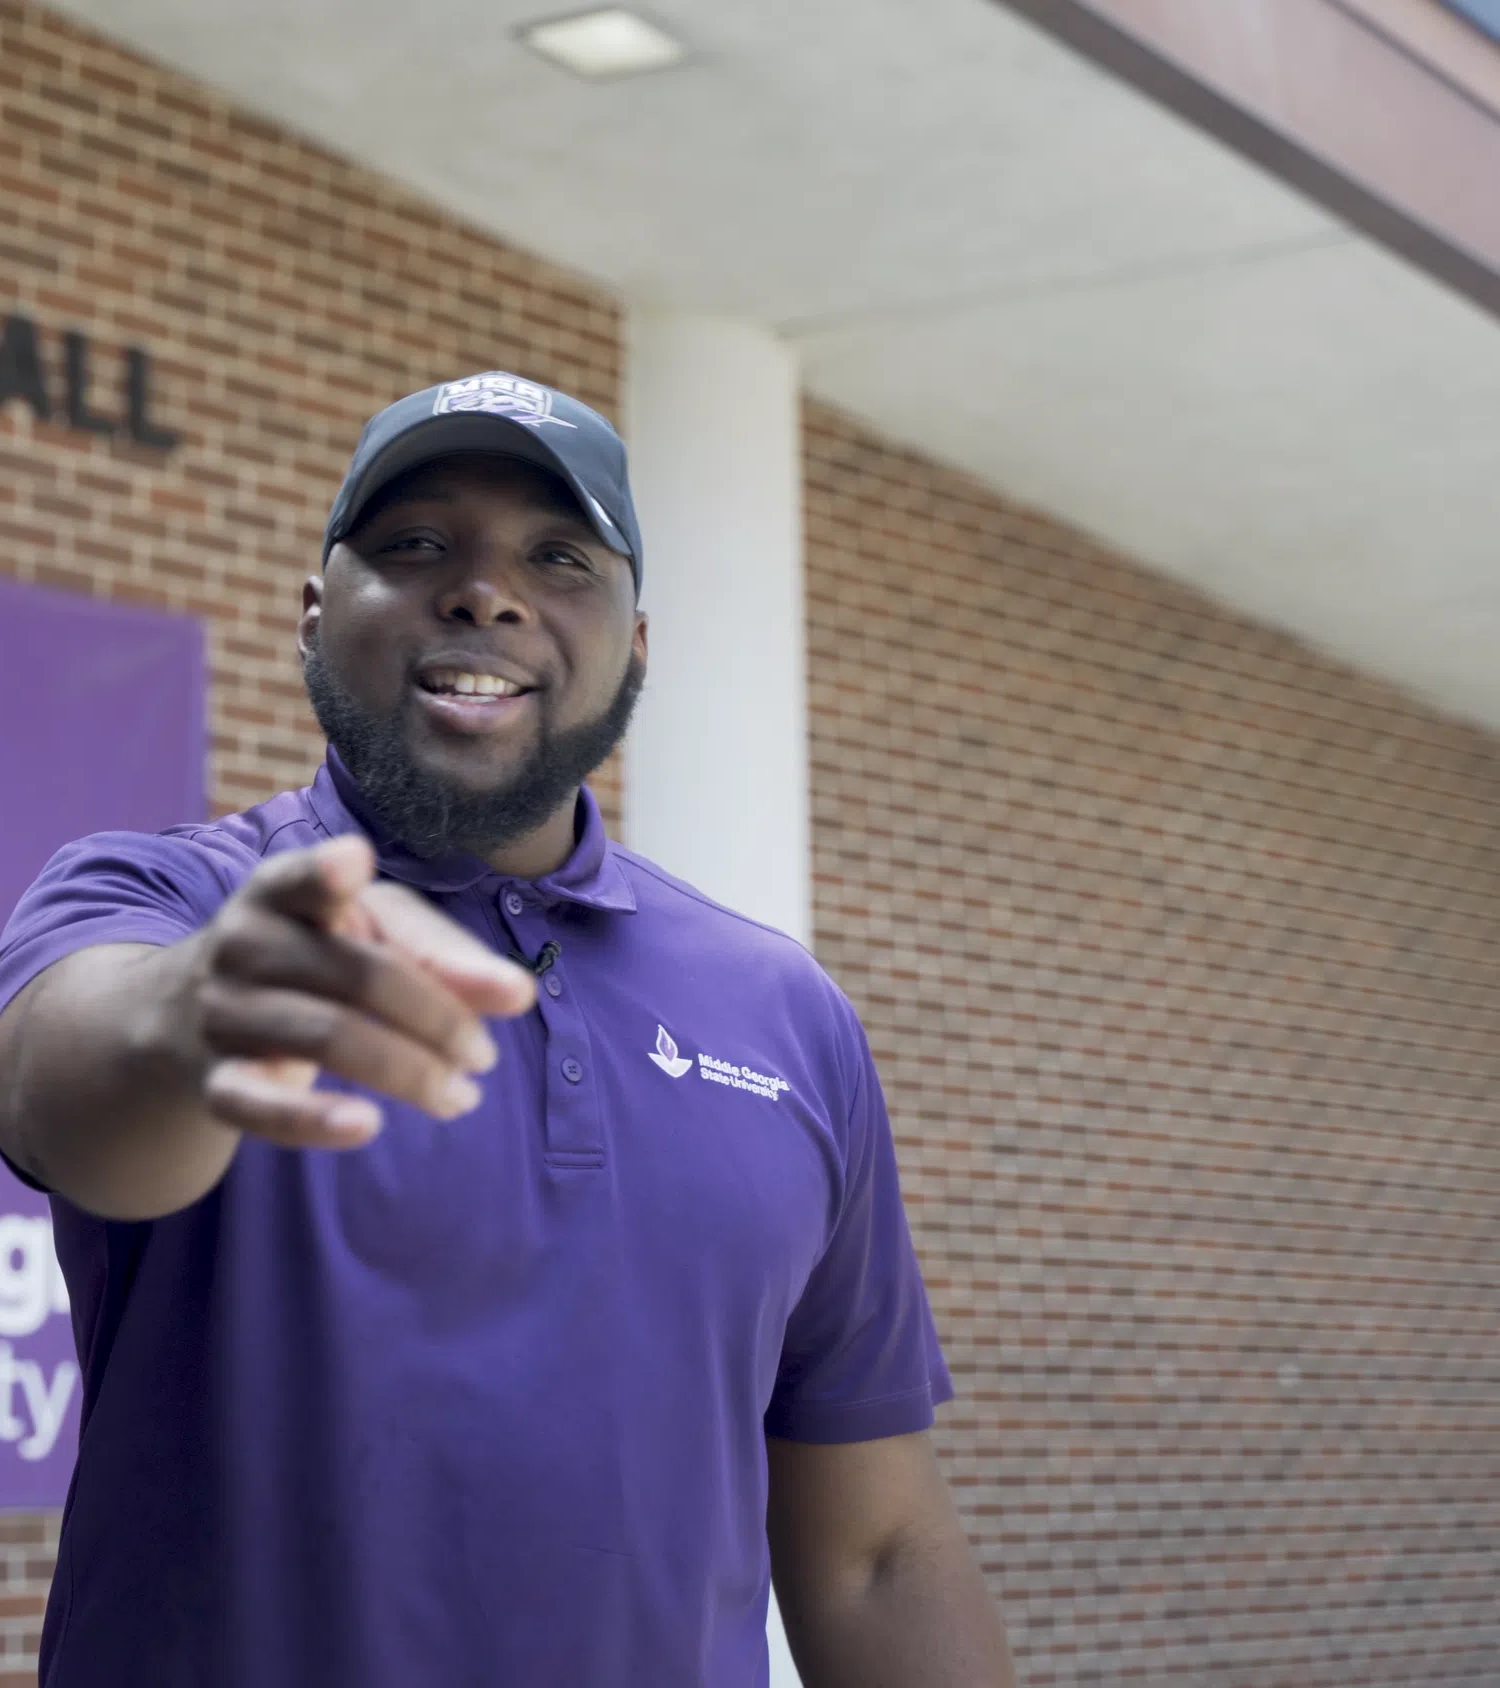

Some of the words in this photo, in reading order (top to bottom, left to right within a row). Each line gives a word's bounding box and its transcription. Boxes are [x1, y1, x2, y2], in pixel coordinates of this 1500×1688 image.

[698, 1053, 740, 1077] Middle
[741, 1066, 790, 1091] Georgia
[700, 1067, 730, 1085] State
[730, 1076, 779, 1101] University
